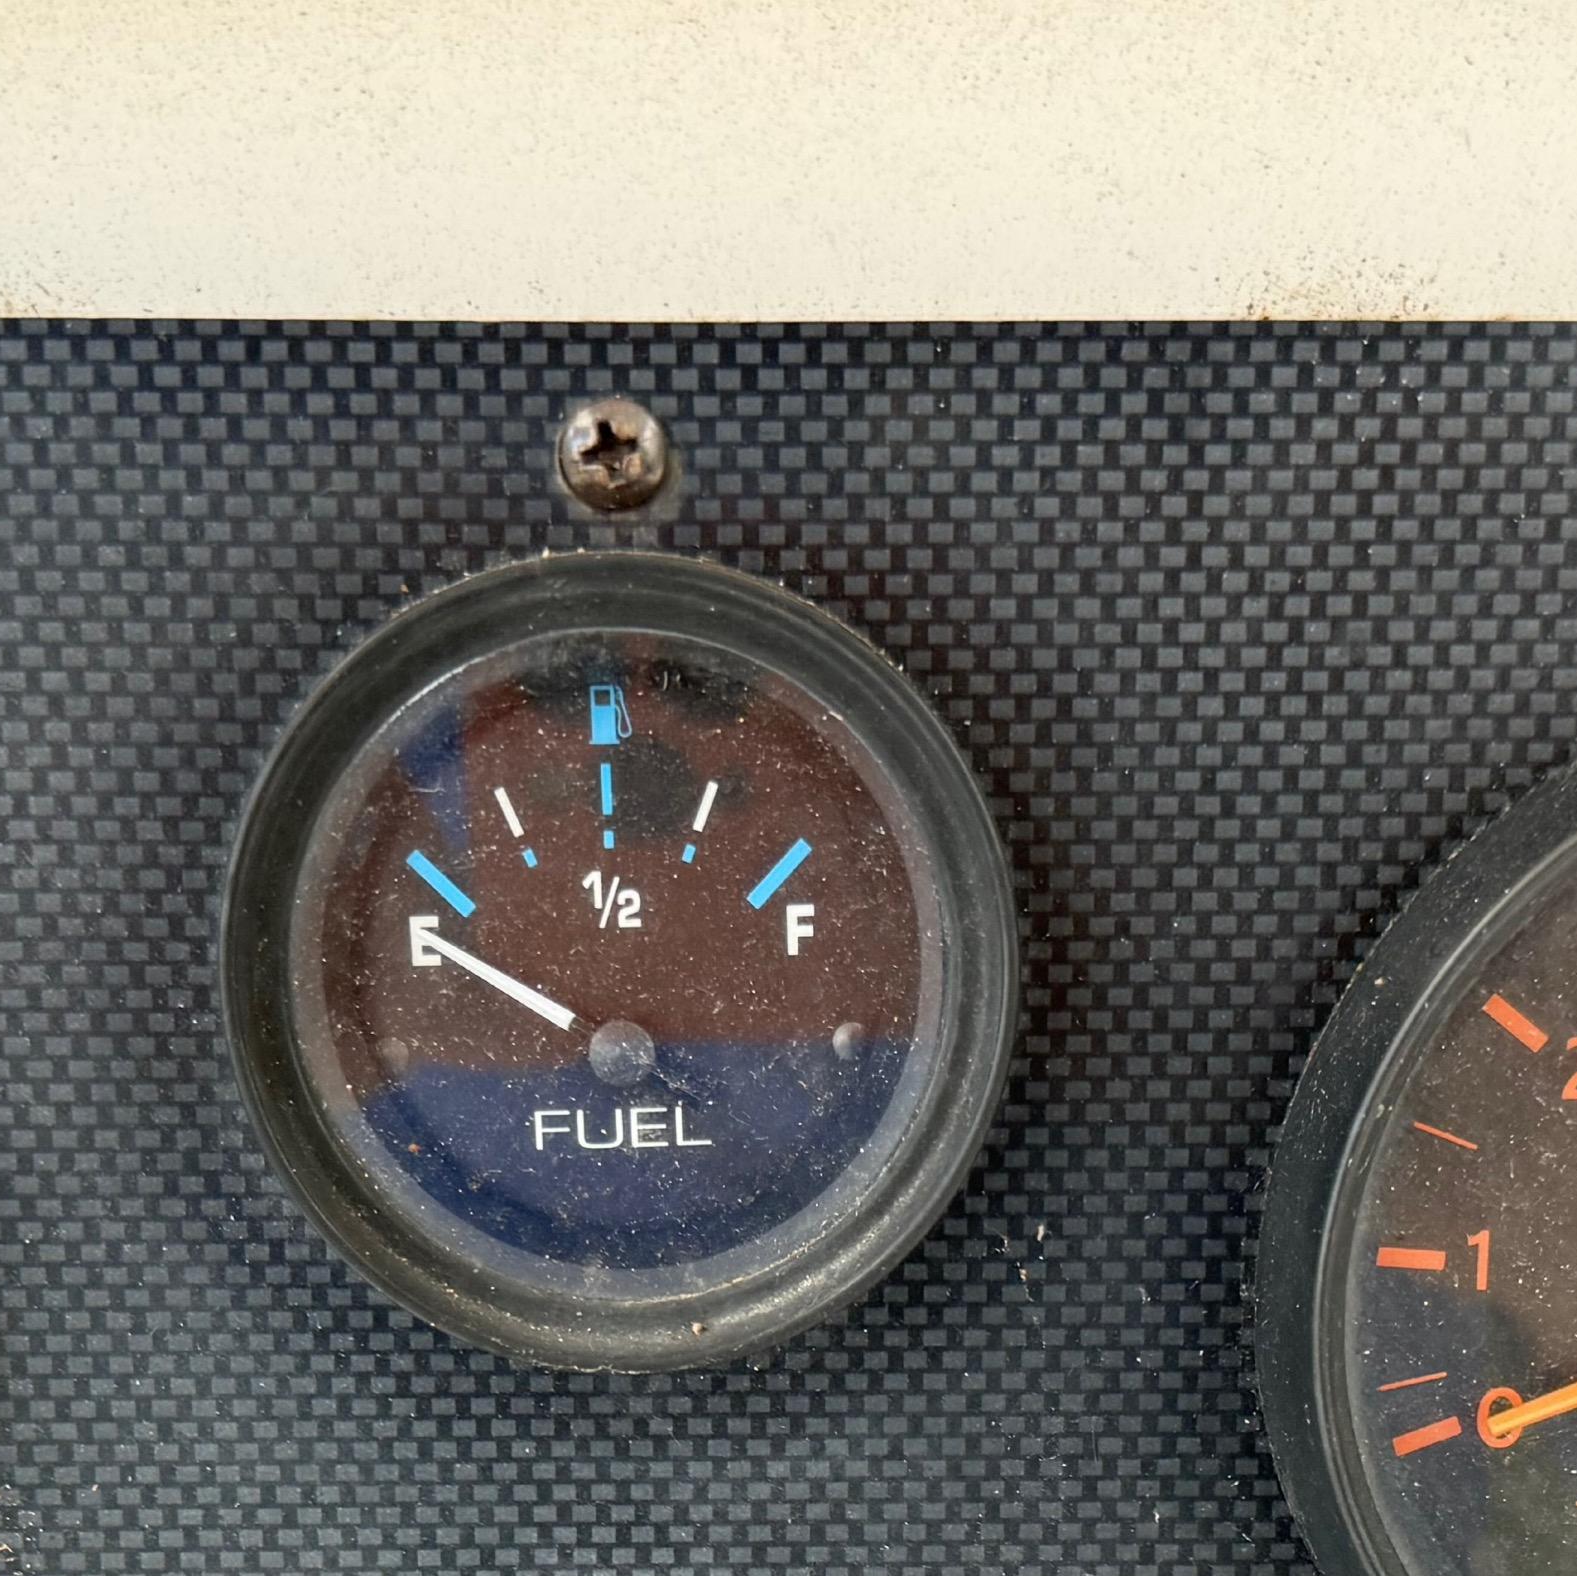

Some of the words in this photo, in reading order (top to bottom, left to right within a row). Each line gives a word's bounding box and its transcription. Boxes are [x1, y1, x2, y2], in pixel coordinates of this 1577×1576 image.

[409, 915, 442, 967] E
[786, 904, 815, 956] F
[533, 1106, 713, 1151] FUEL
[1467, 1229, 1491, 1291] 1
[1476, 1386, 1524, 1449] 0
